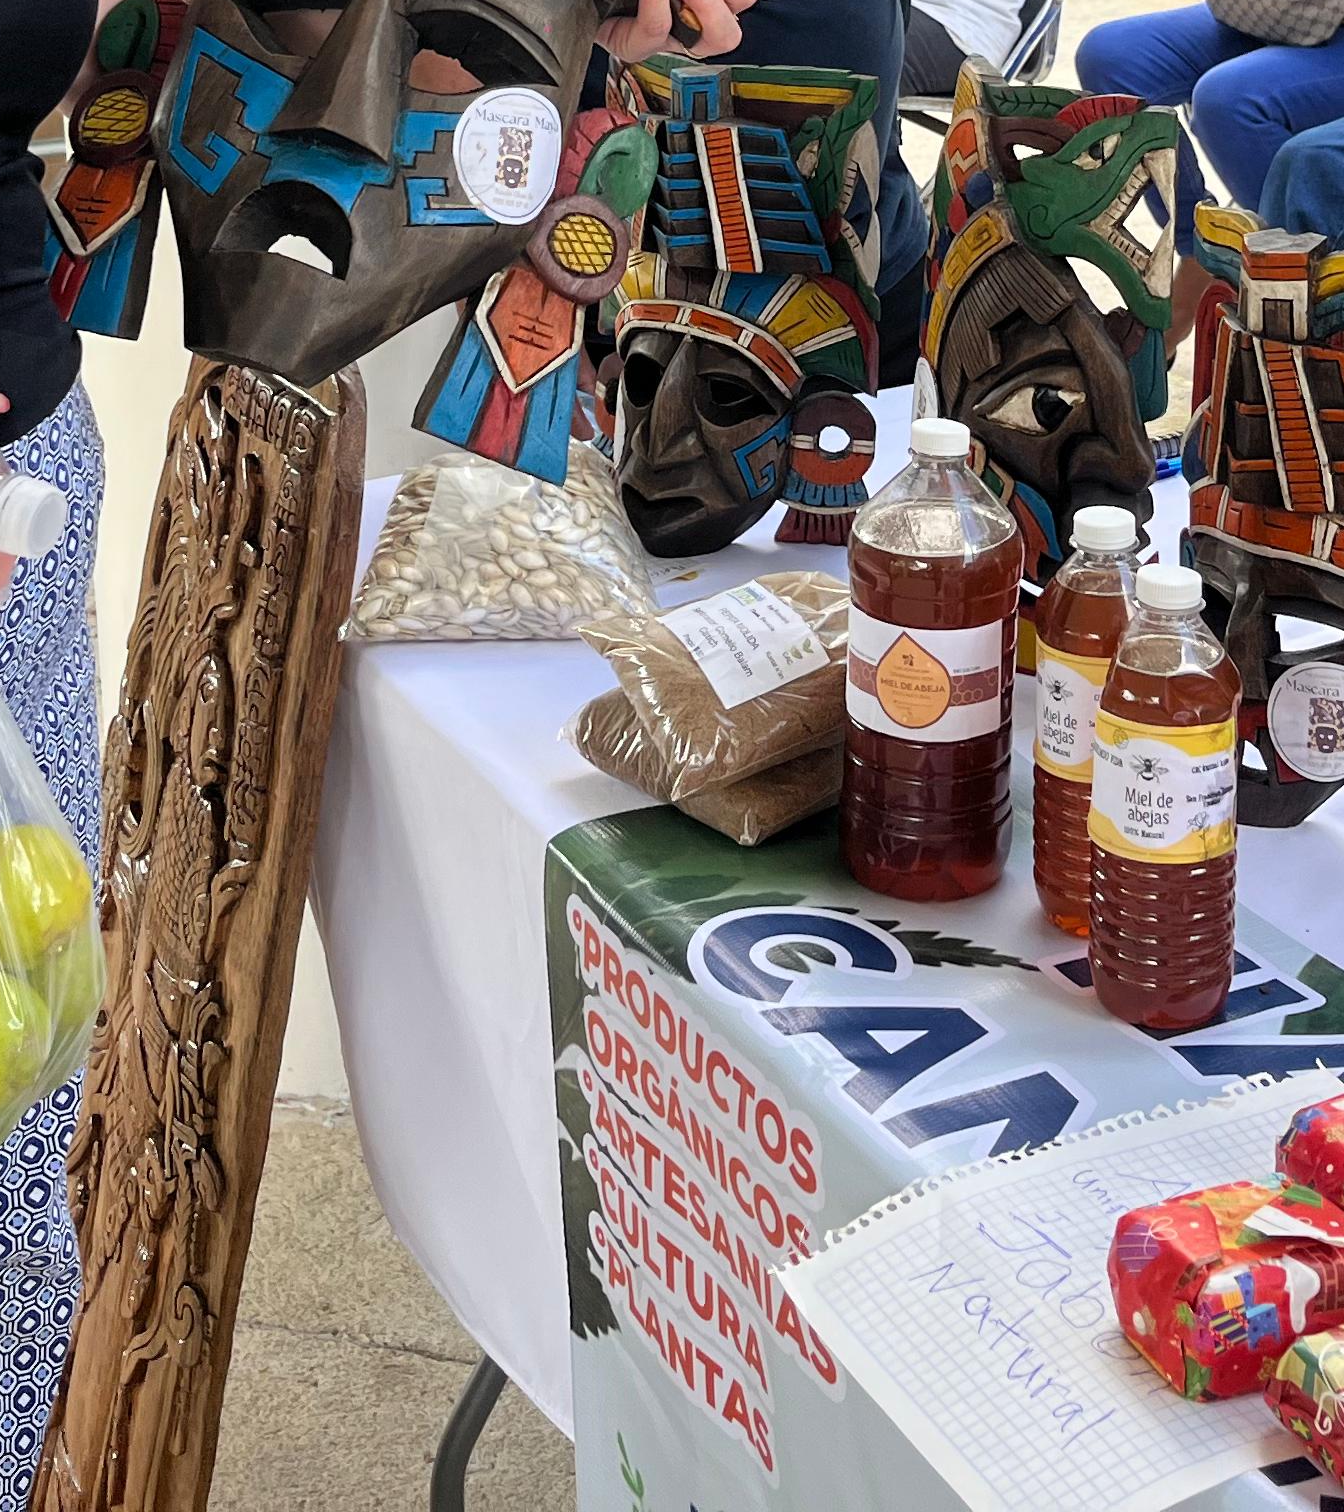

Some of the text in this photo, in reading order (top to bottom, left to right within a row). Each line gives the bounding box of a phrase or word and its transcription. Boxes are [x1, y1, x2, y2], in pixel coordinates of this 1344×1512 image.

[733, 650, 754, 678] Balam
[880, 677, 946, 694] MIEL DE ABEJA
[1285, 677, 1340, 698] Mascara
[1063, 713, 1077, 730] de
[1043, 723, 1075, 745] abejas
[1125, 787, 1174, 809] Miel de
[1128, 806, 1170, 828] abejas
[1141, 829, 1165, 839] Natural
[583, 919, 817, 1194] PRODUCTOS
[587, 1009, 813, 1266] ORGÁNICOS
[601, 1168, 769, 1395] CULTURA
[609, 1240, 774, 1473] PLANTAS
[908, 1261, 1116, 1450] Natural
